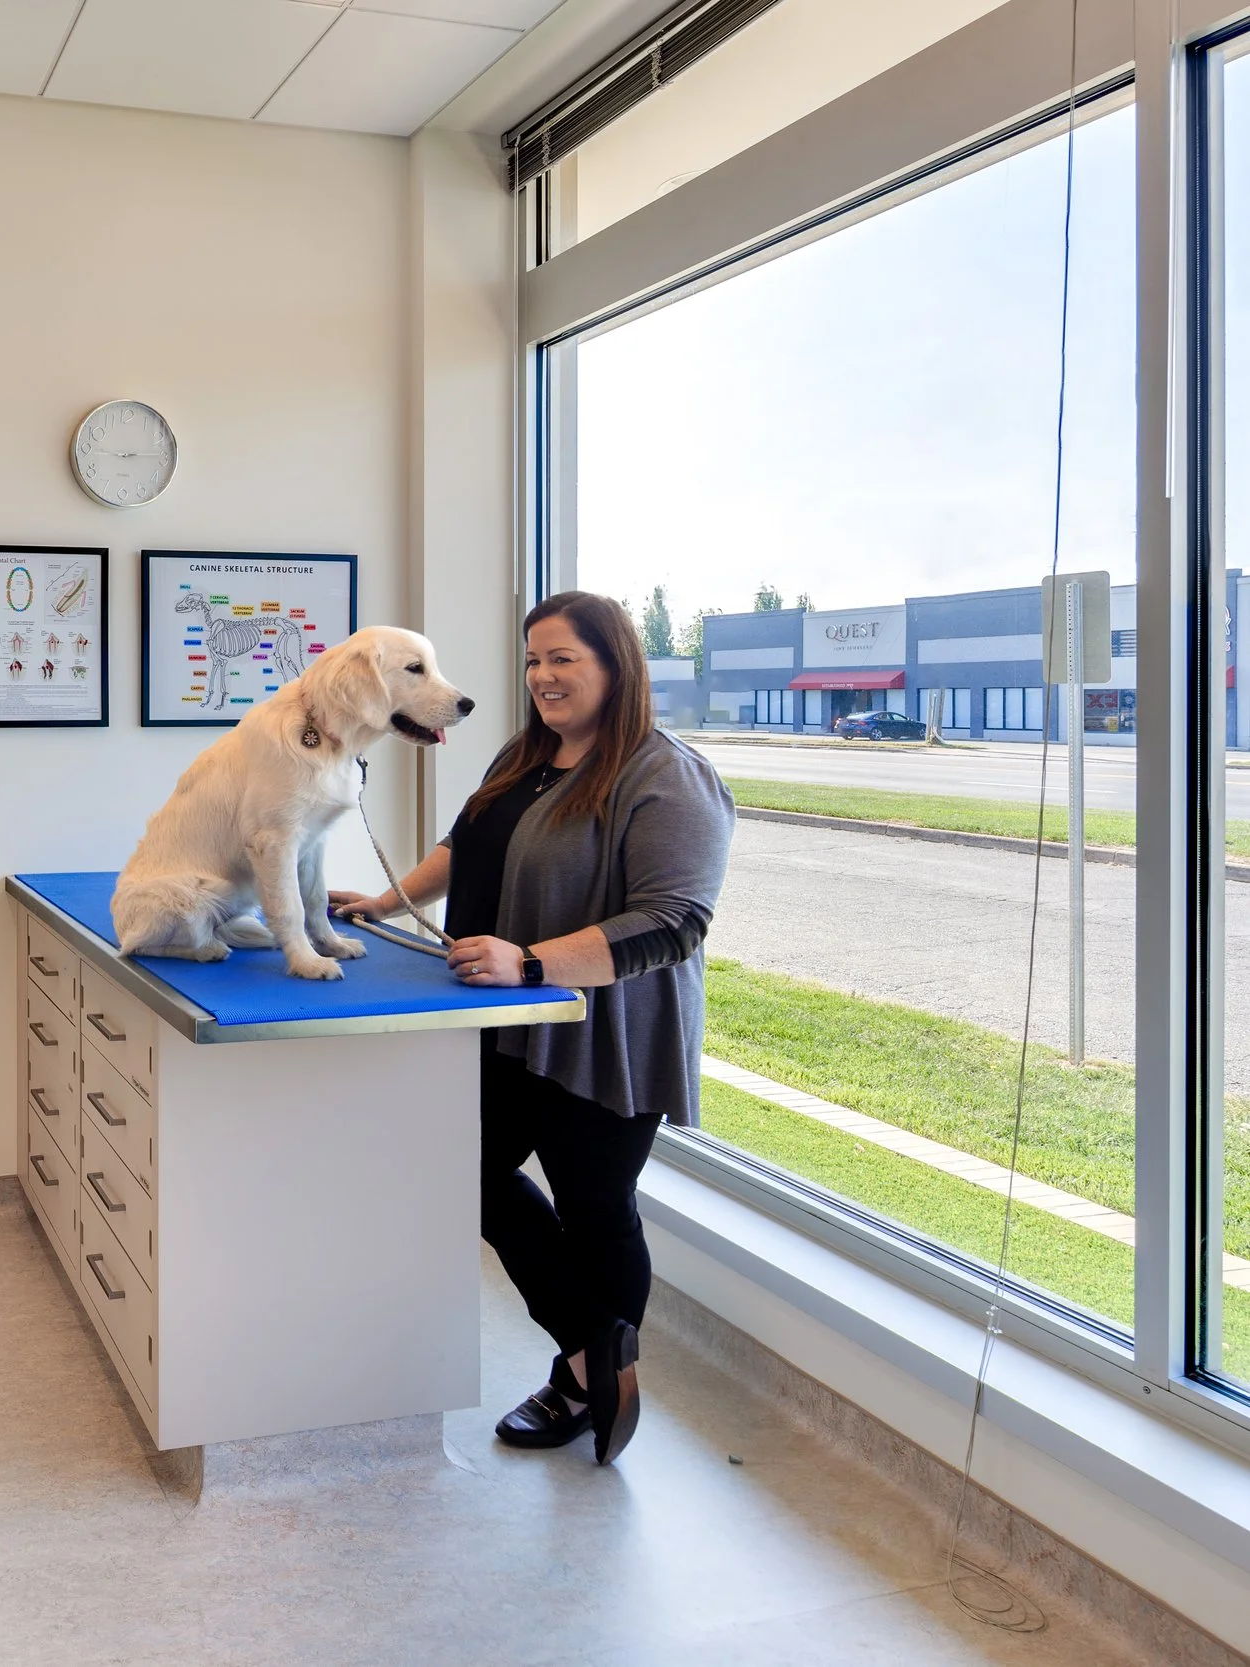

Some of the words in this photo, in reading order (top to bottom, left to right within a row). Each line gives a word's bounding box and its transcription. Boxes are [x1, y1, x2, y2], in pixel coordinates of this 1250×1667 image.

[104, 414, 114, 429] 11
[120, 409, 134, 424] 12
[88, 426, 106, 441] 10
[153, 432, 163, 446] 2
[81, 442, 92, 458] 9
[159, 451, 168, 467] 3
[86, 462, 96, 478] 8
[150, 470, 158, 484] 4
[100, 479, 110, 496] 7
[117, 485, 128, 500] 6
[136, 482, 146, 498] 5
[826, 622, 880, 642] QUEST
